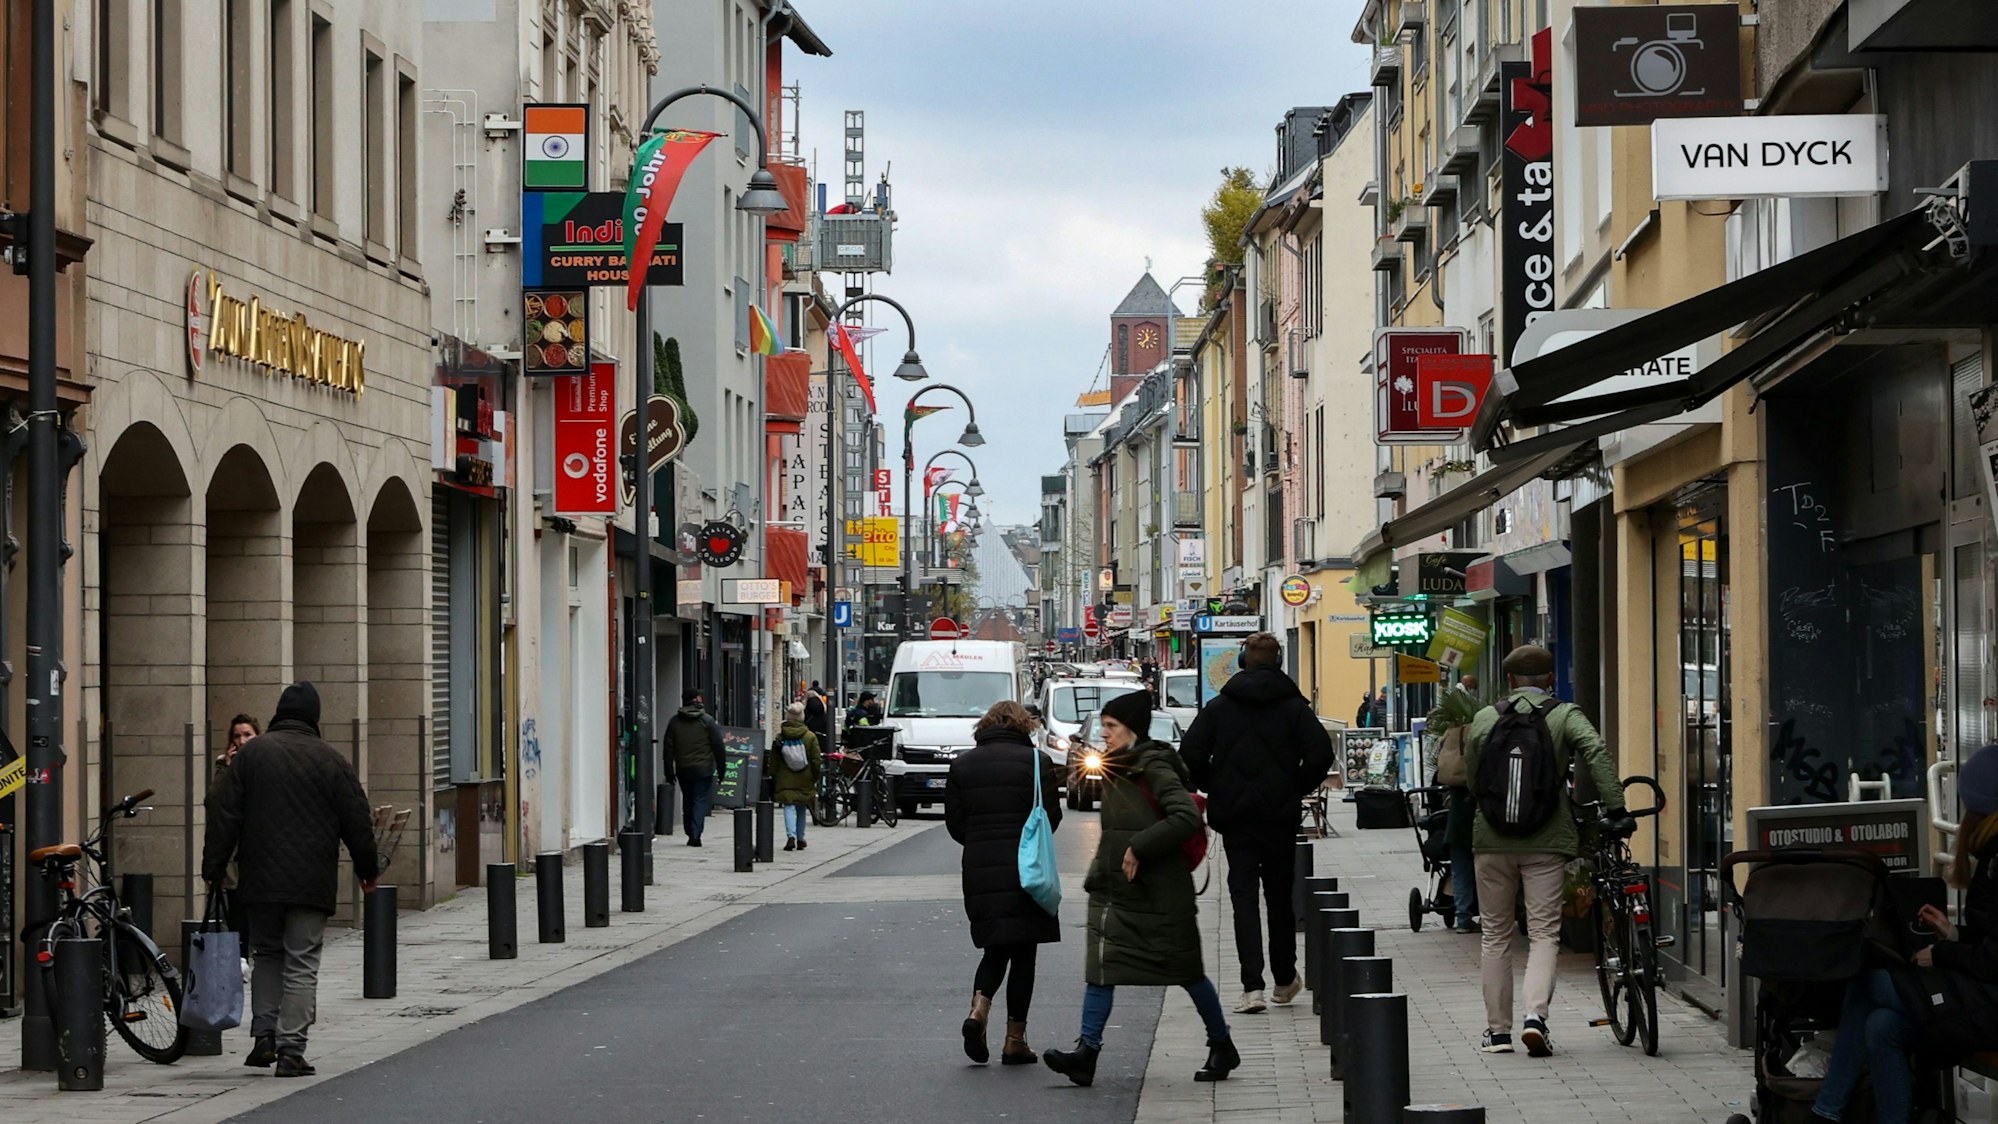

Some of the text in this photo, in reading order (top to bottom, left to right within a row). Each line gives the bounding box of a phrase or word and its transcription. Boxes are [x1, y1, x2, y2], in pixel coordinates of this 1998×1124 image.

[1680, 140, 1852, 169] VAN DYCK
[1517, 160, 1552, 206] ta
[1518, 209, 1552, 243] &
[551, 255, 677, 267] CURRY BAATI
[587, 270, 630, 281] HOUS
[587, 373, 597, 412] Premium
[599, 390, 610, 412] Shop
[592, 428, 608, 504] vodafone
[792, 433, 806, 532] TAPAS
[702, 526, 737, 539] ITALIAN
[701, 546, 738, 563] SOULFOOD
[740, 581, 778, 591] OTTO'S
[1423, 578, 1464, 591] LUDA
[740, 591, 778, 601] BURGER
[1199, 616, 1210, 630] U
[1214, 620, 1258, 628] Kartäuserhof
[1374, 619, 1428, 643] KIOSK
[1834, 828, 1844, 843] &
